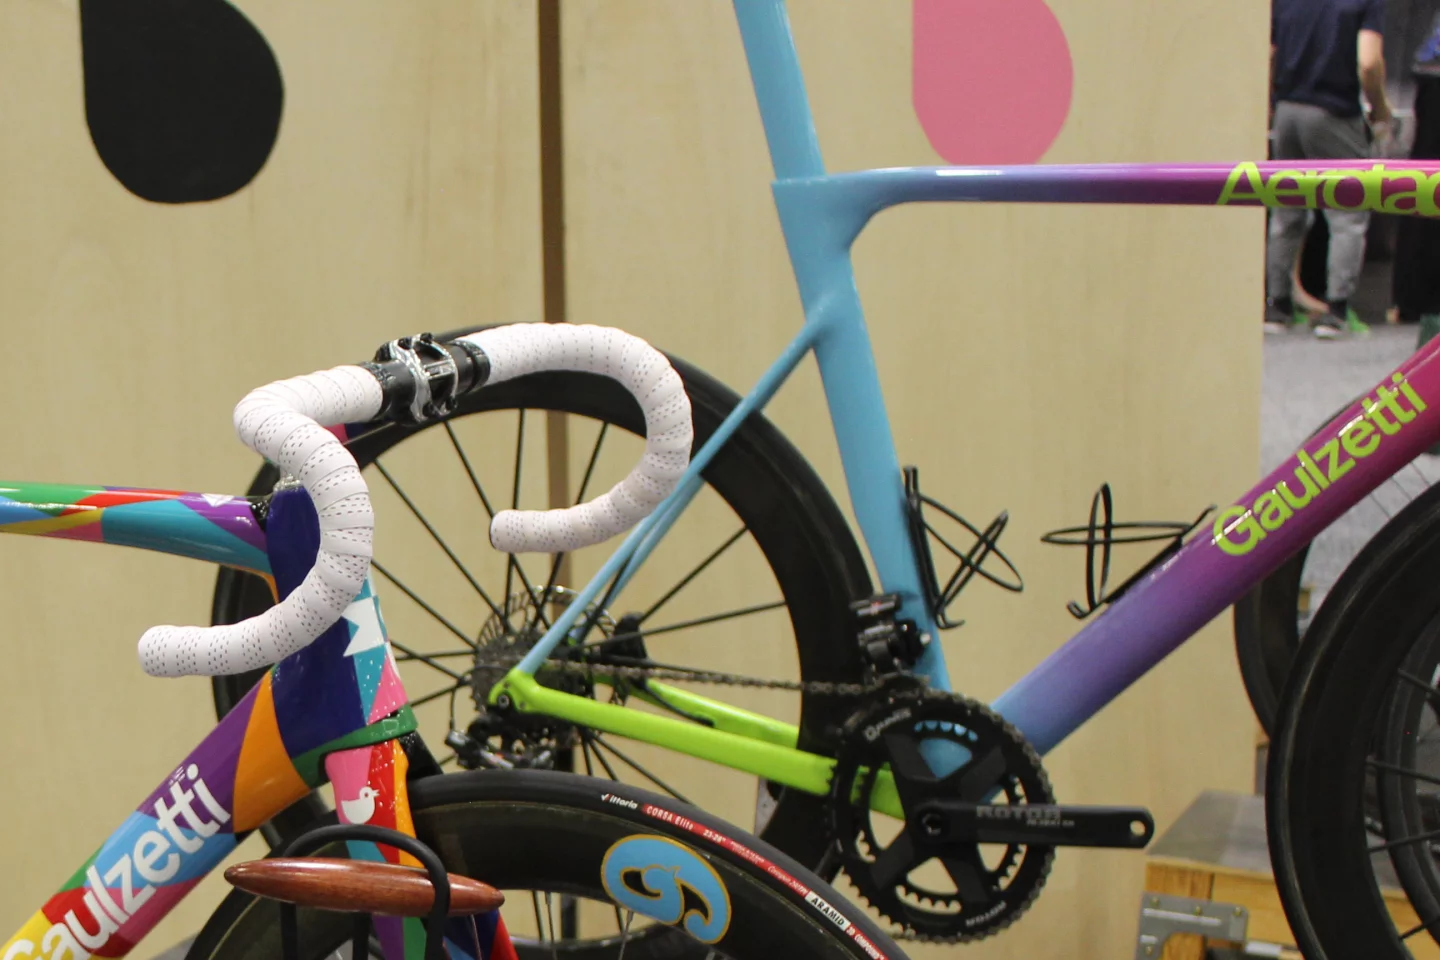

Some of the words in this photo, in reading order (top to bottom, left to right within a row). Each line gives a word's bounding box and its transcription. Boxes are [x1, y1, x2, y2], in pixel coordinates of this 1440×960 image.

[1212, 372, 1427, 556] Gaulzetti
[600, 793, 638, 810] Vittoria
[646, 805, 673, 822] CORSA
[674, 816, 694, 831] Elite
[811, 897, 845, 926] ARAMID
